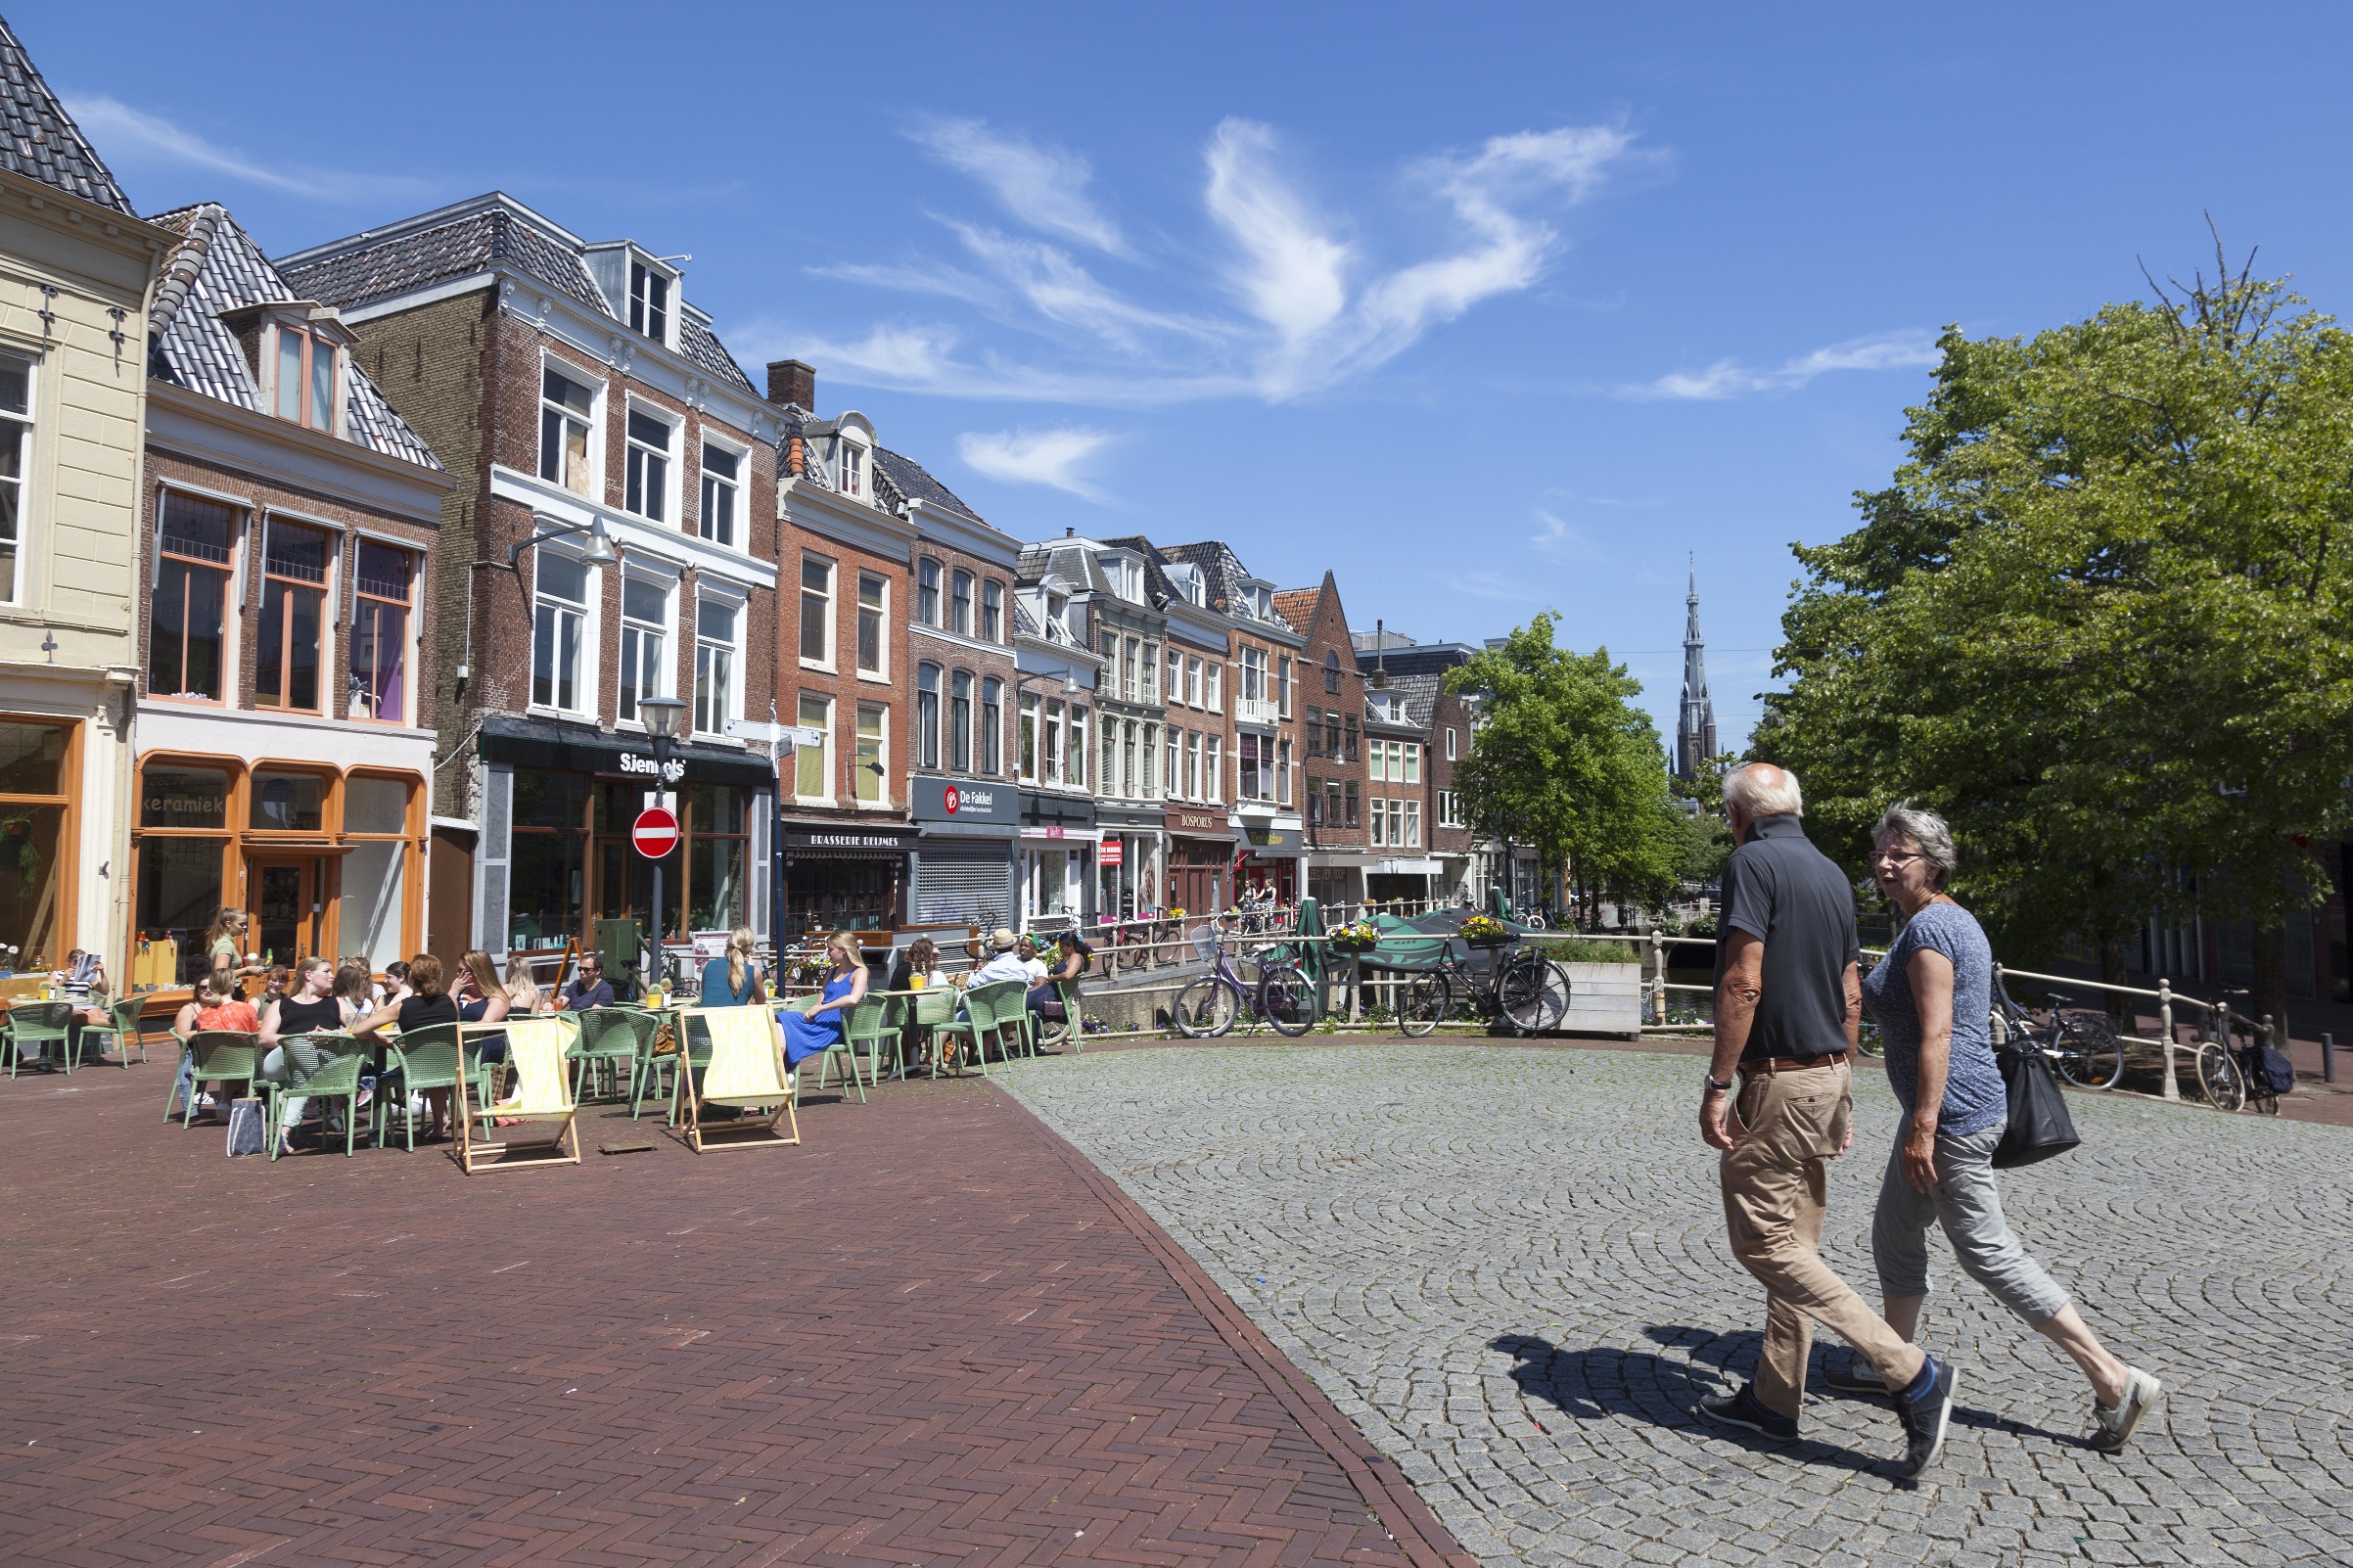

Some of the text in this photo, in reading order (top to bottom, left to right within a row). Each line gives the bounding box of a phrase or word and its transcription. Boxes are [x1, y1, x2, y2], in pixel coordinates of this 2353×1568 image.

[143, 796, 223, 812] keramiek
[959, 790, 992, 806] De Fakkel
[348, 804, 397, 820] atelier
[1181, 814, 1213, 829] BOSPORUS
[810, 835, 899, 847] BRASSERIE REIJMES
